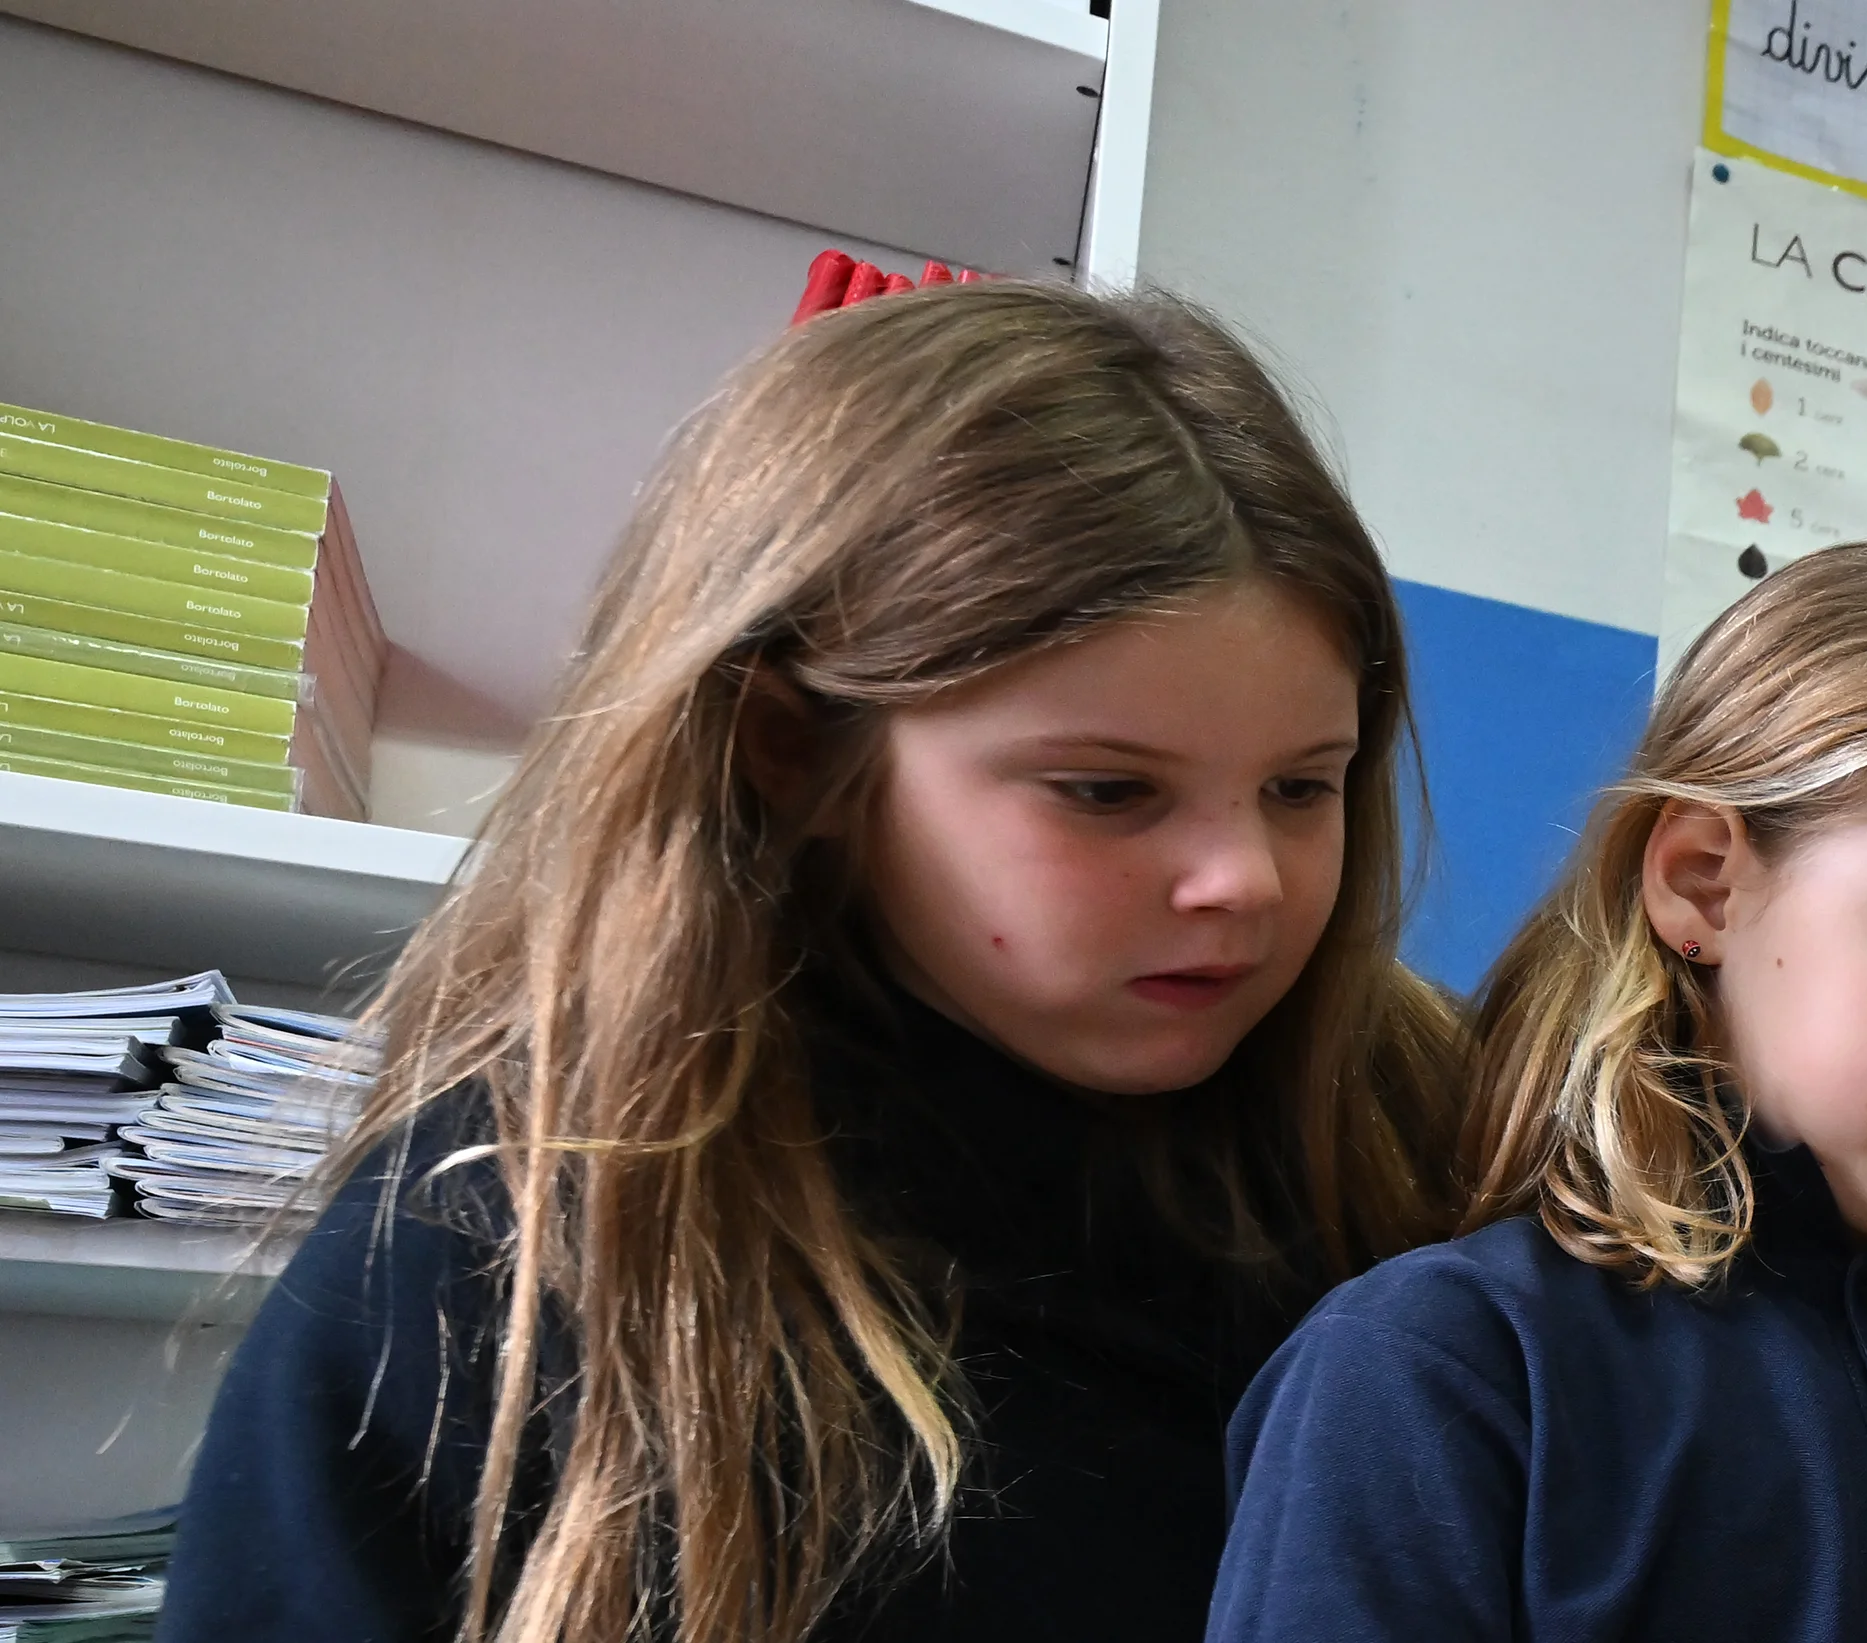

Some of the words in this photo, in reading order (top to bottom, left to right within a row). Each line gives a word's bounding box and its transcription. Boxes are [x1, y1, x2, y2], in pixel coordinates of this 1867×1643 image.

[1751, 223, 1812, 279] LA
[1742, 319, 1801, 350] Indica
[1752, 347, 1842, 383] centesimi
[213, 457, 268, 477] Bortolato
[207, 490, 262, 510] Bortolato
[198, 529, 254, 549] Bortolato
[193, 564, 249, 584] Bortolato
[186, 600, 242, 620] Bortolato
[184, 633, 239, 652] Bortolato
[174, 696, 229, 714] Bortolato
[169, 728, 225, 746] Bortolato
[173, 758, 228, 777] Bortolato
